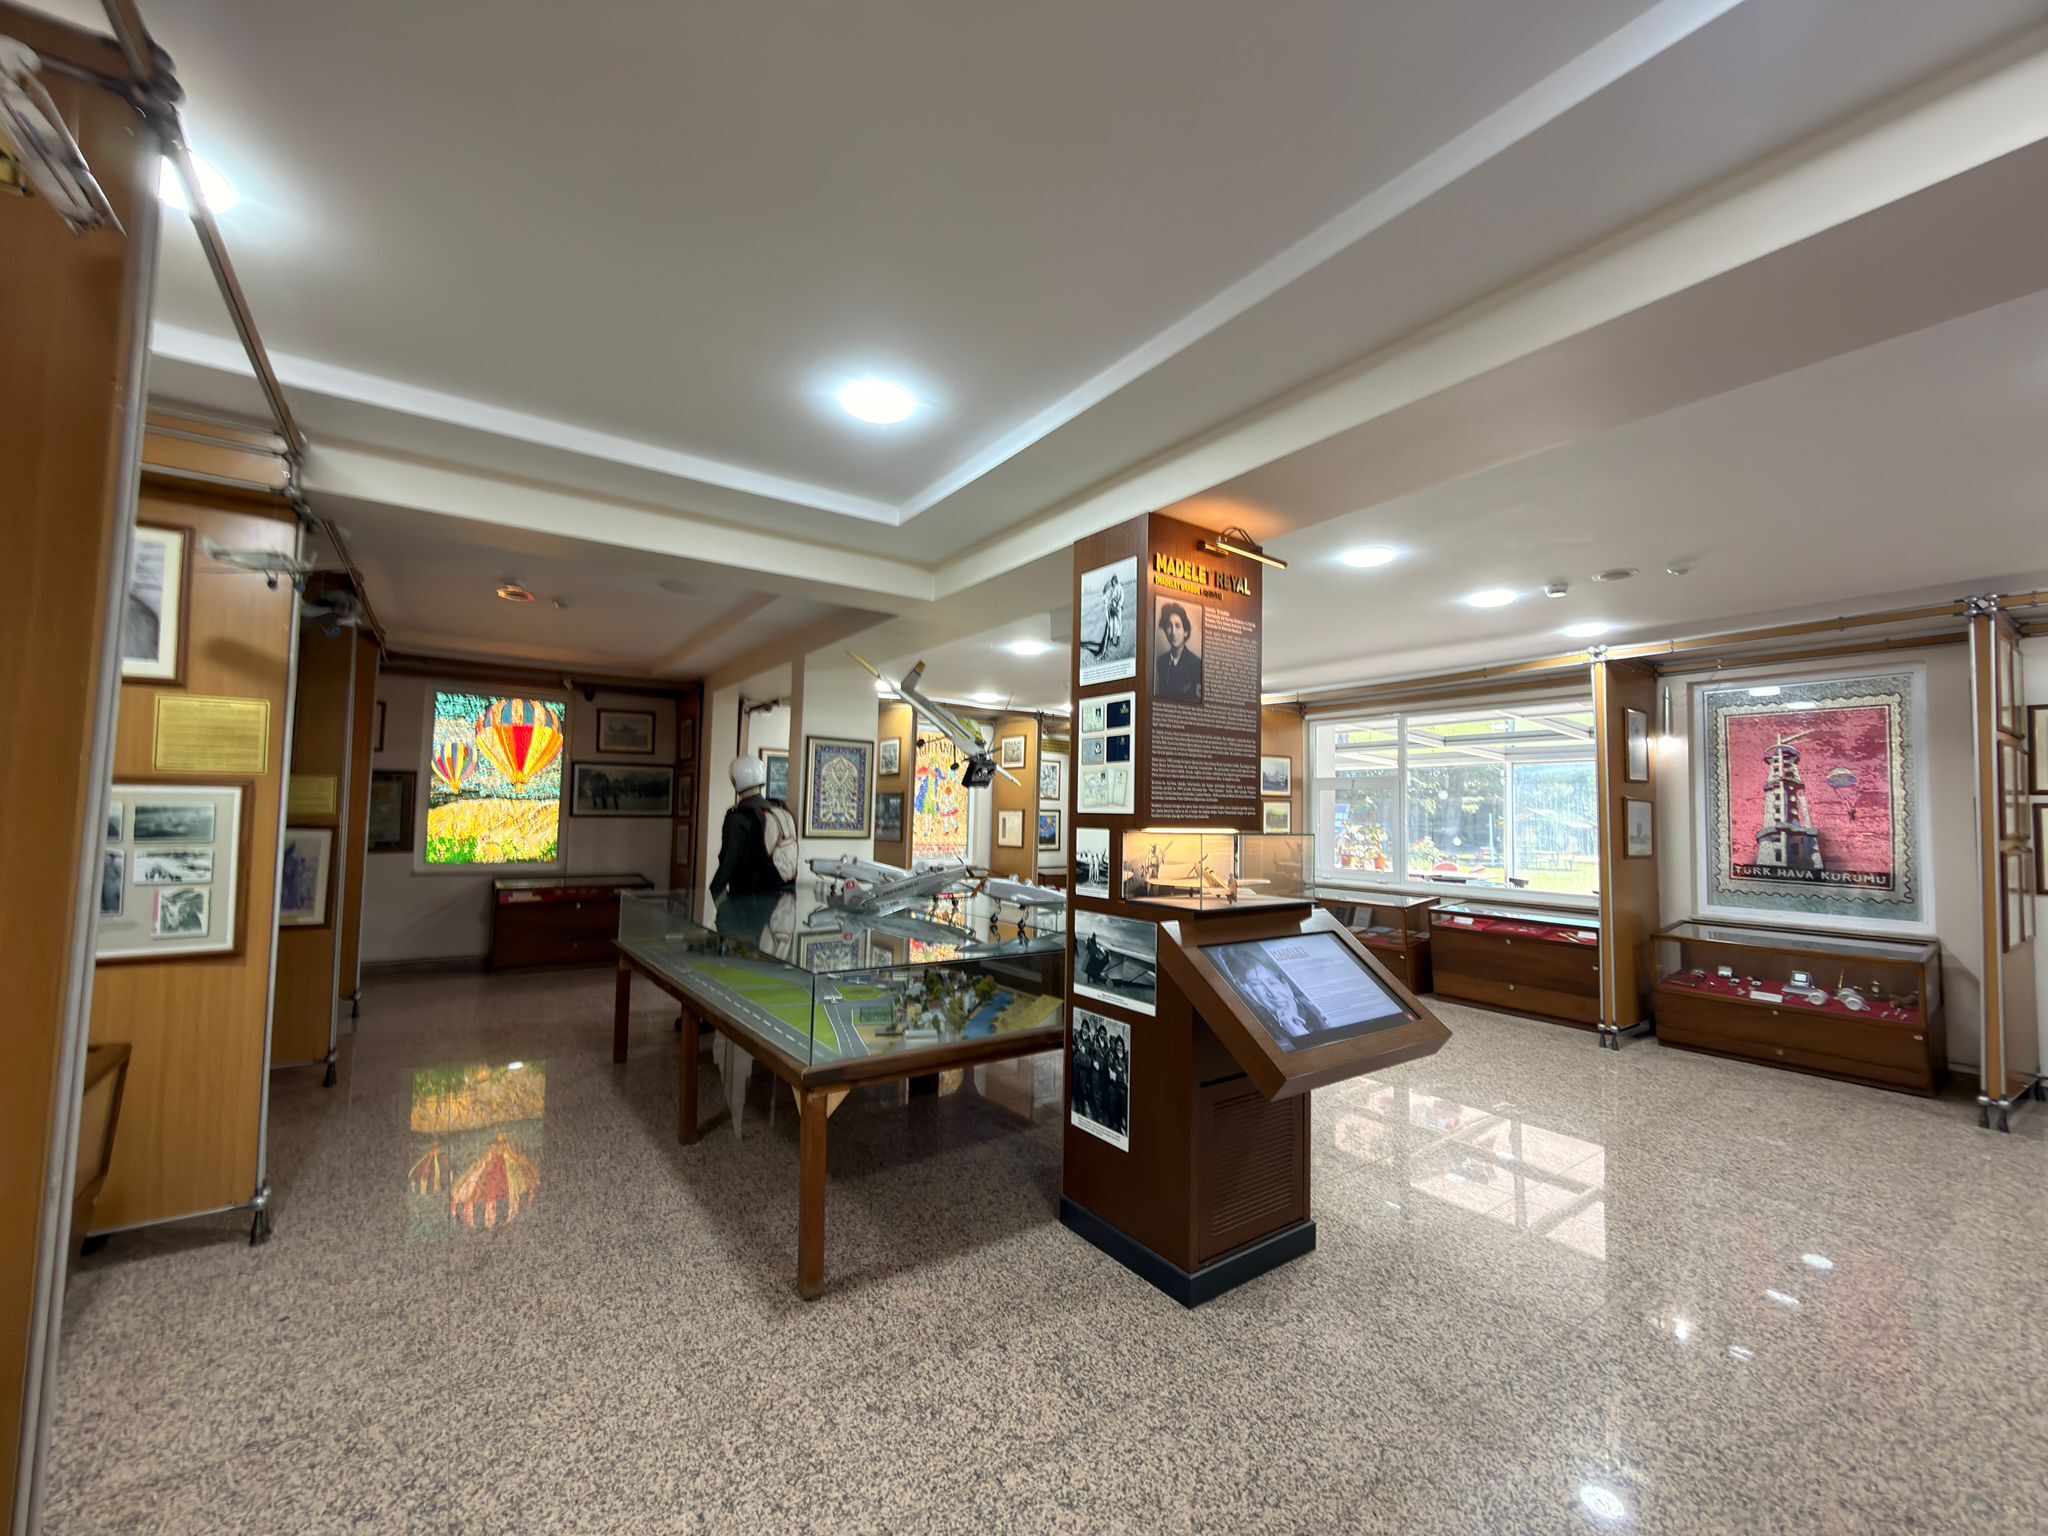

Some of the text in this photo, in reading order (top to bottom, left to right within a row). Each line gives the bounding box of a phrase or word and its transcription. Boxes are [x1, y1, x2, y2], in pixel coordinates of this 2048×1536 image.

[1156, 552, 1213, 584] MADELET
[1216, 570, 1251, 596] REYAL
[1777, 868, 1815, 879] HAVA
[1820, 871, 1887, 884] KURUMU
